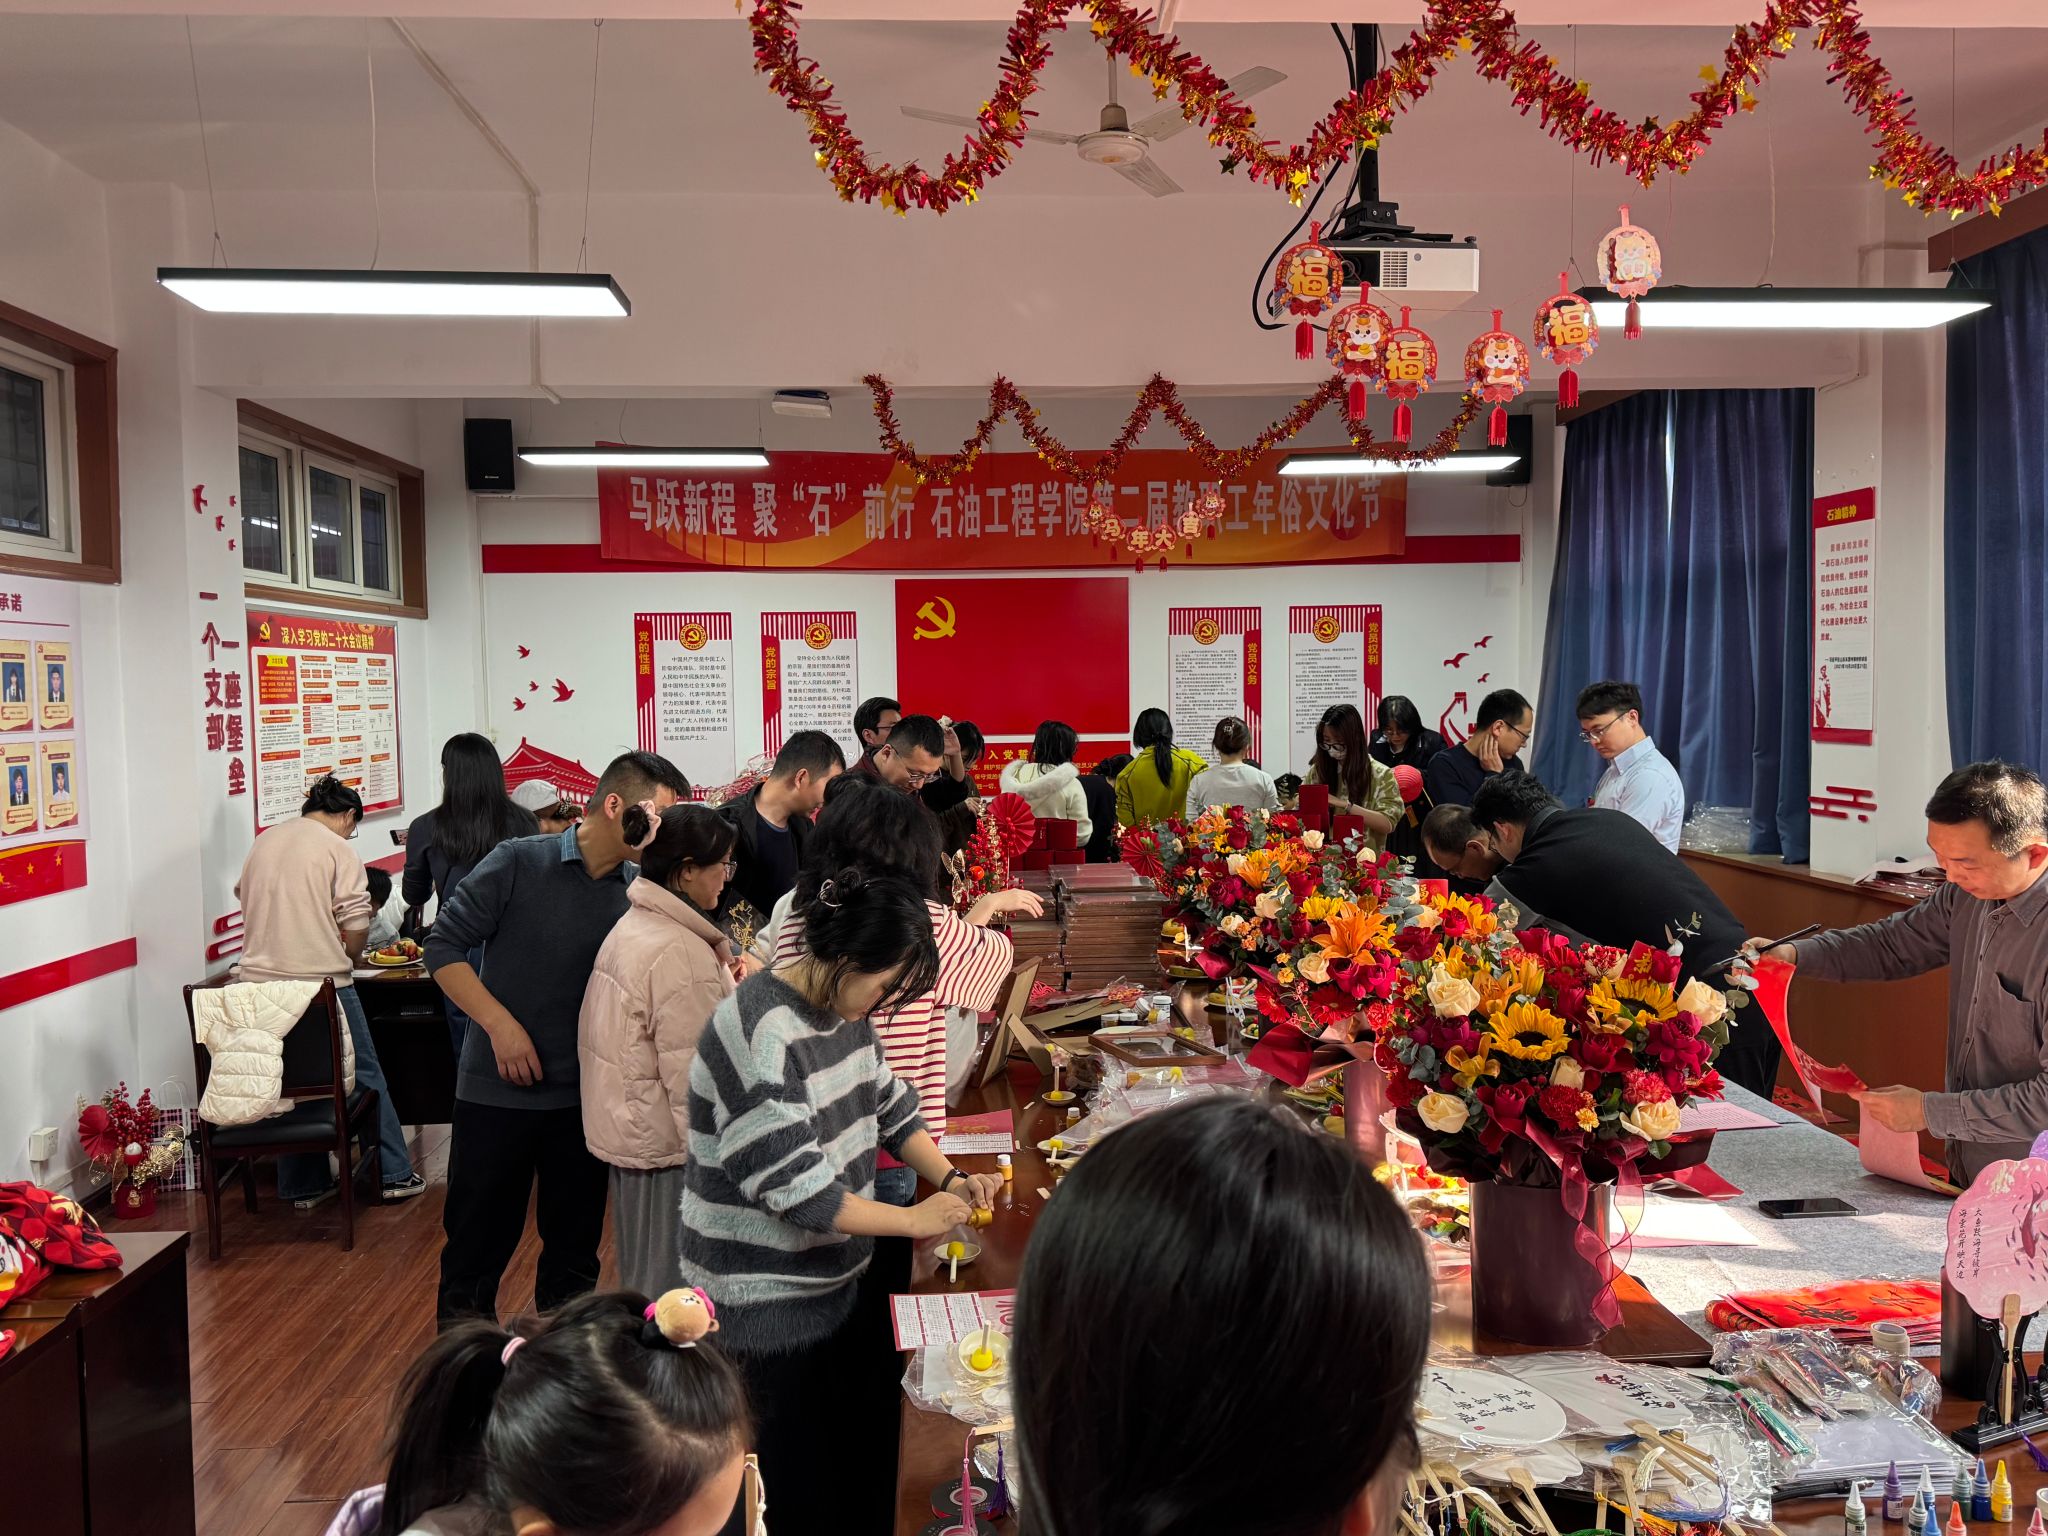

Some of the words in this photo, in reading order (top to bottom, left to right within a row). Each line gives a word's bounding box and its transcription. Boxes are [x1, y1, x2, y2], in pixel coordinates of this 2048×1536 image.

[1289, 256, 1330, 297] 福
[1549, 303, 1589, 346] 福
[1385, 339, 1426, 382] 福
[630, 476, 737, 536] 马跃新程
[280, 626, 375, 650] 深入学习党的二十大会议精神
[638, 631, 650, 675] 党的性质
[1367, 622, 1379, 665] 党员权利
[199, 591, 225, 751] 一个支部
[765, 646, 777, 690] 党的宗旨
[1247, 642, 1258, 685] 党员义务
[221, 640, 247, 796] 一座堡垒
